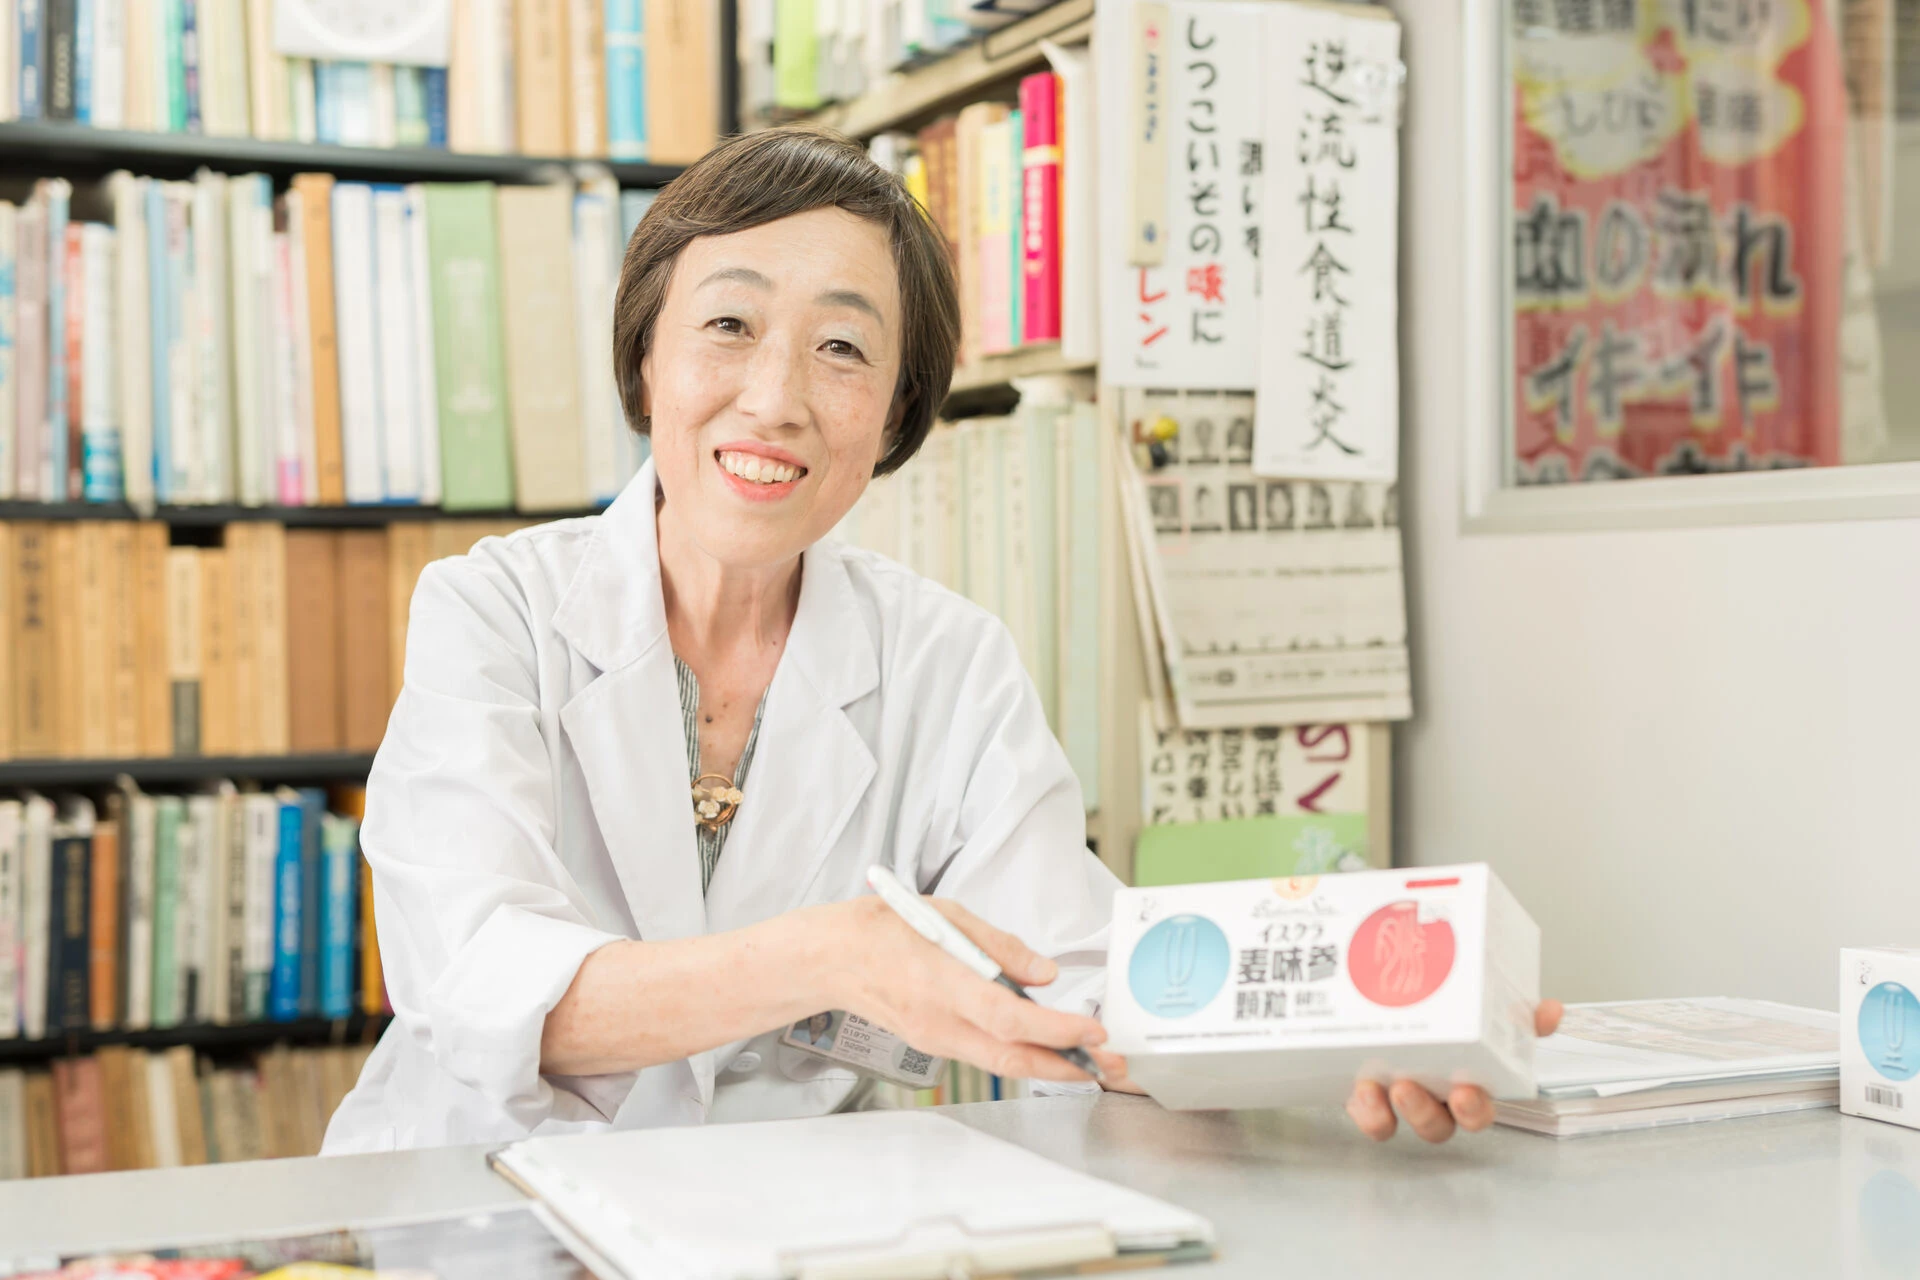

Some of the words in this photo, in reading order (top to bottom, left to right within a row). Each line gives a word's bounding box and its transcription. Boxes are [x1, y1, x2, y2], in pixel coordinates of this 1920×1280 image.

[1298, 39, 1362, 456] 逆流性食道炎
[1257, 921, 1325, 944] イスクラ
[1237, 944, 1338, 985] 麦味参
